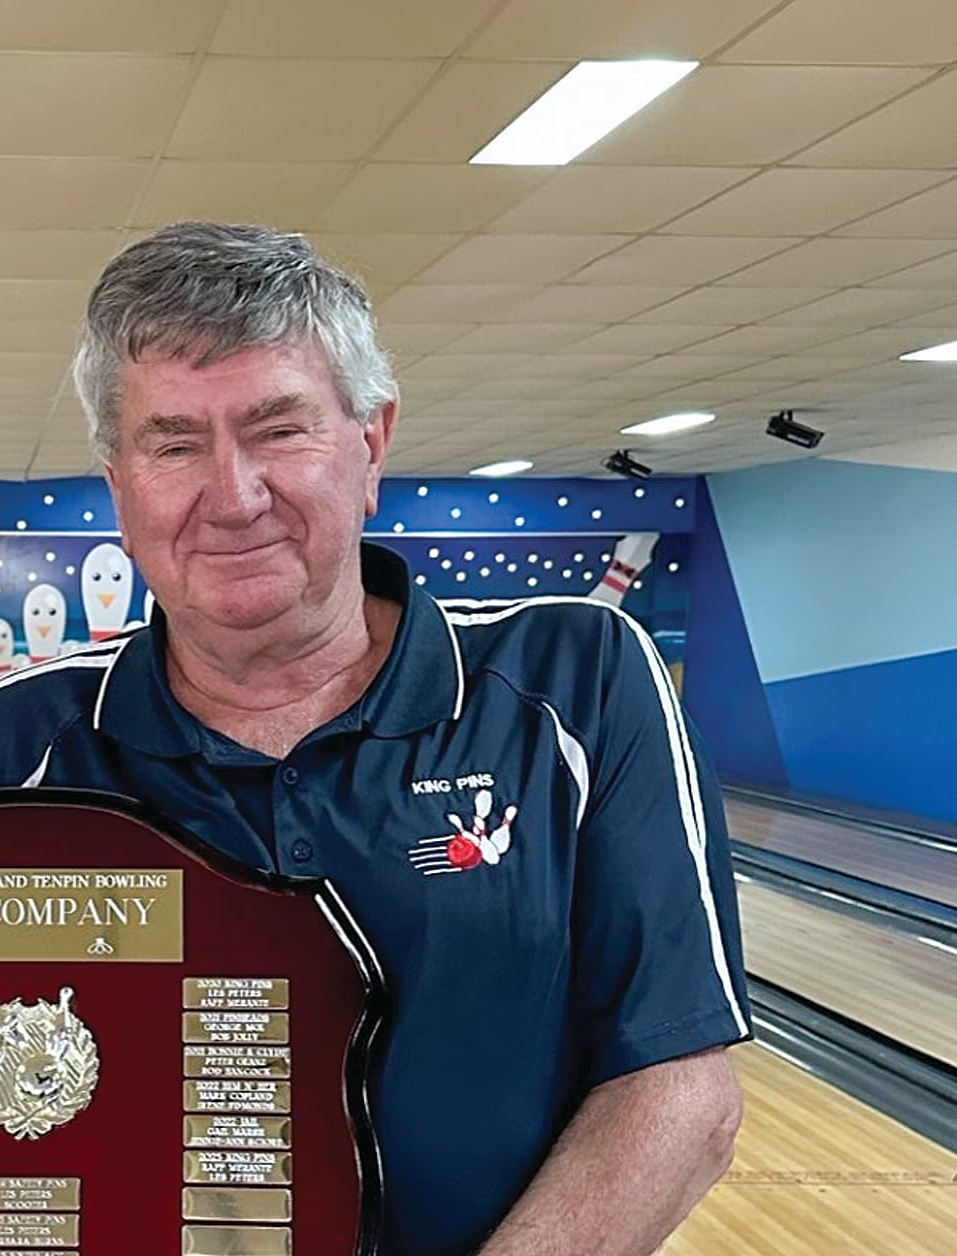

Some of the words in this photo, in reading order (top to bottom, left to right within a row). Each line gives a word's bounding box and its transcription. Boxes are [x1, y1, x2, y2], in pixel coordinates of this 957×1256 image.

[411, 779, 452, 795] KING
[456, 773, 495, 790] PINS
[32, 874, 90, 889] TENPIN
[95, 874, 167, 889] BOWLING
